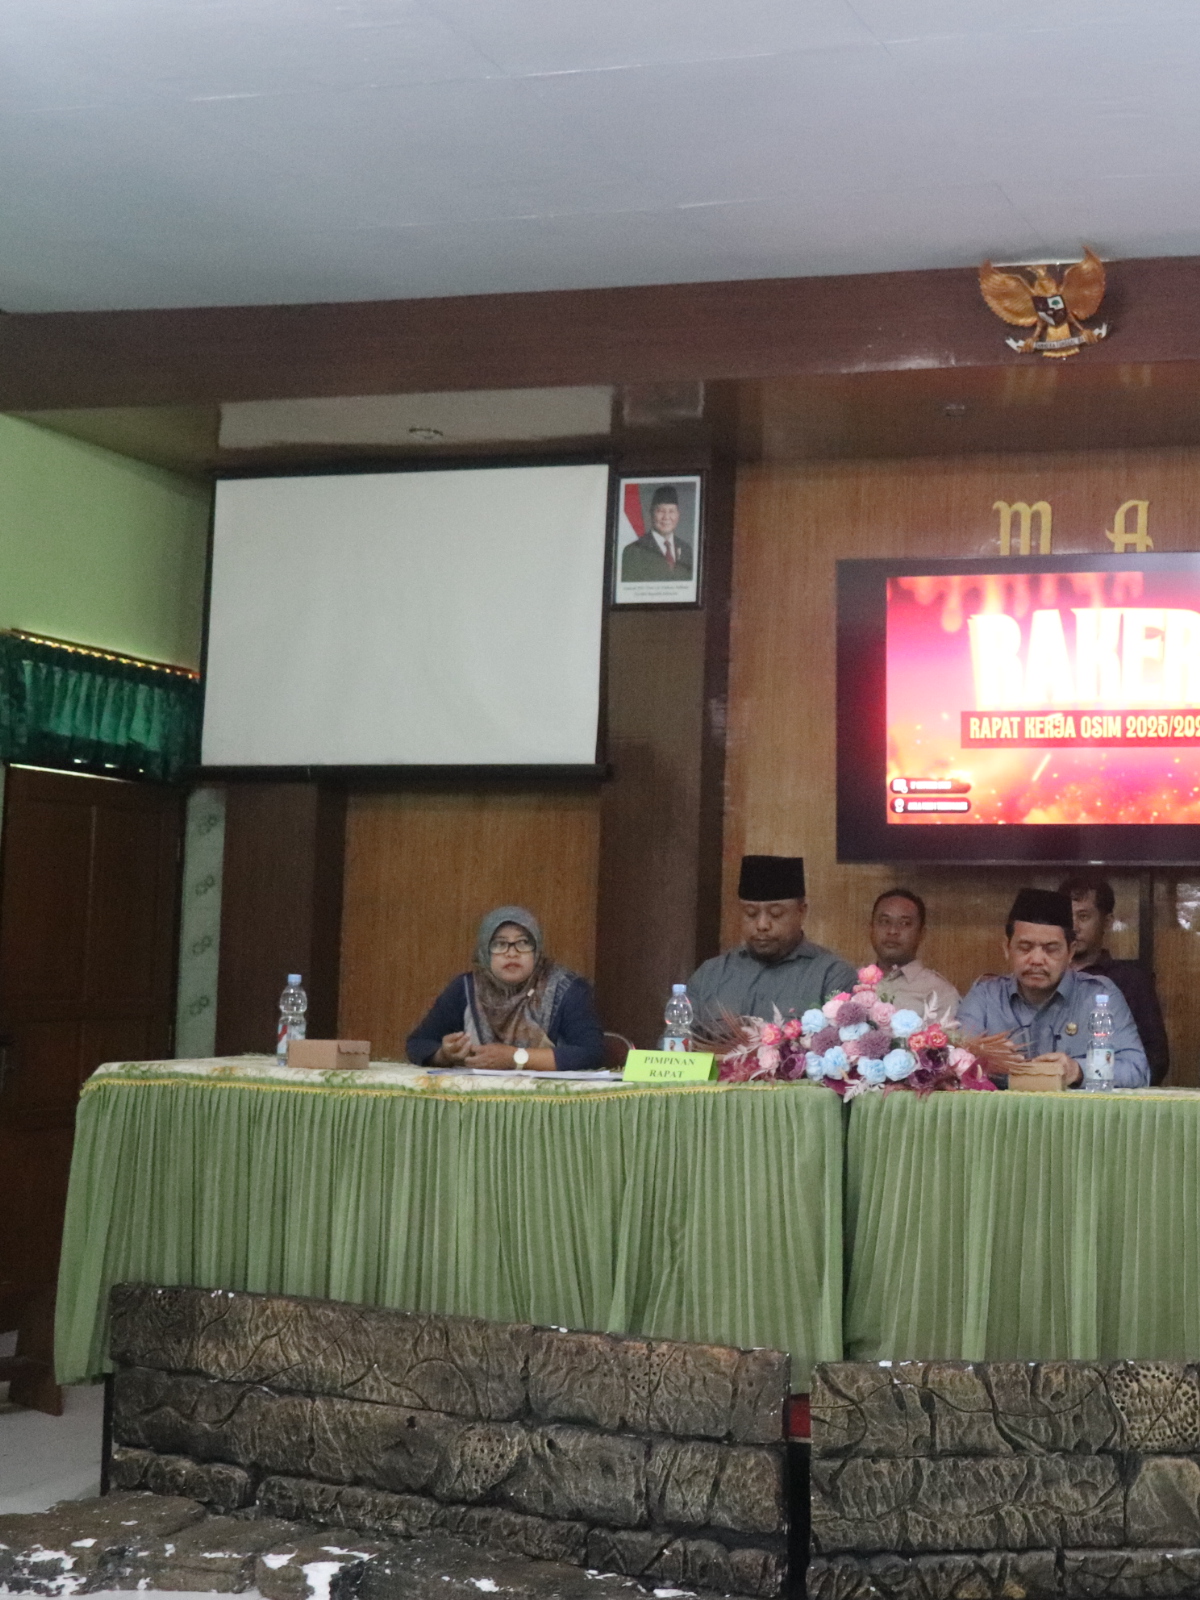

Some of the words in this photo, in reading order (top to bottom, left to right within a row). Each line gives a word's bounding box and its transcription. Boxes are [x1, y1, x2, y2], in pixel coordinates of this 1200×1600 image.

[969, 717, 1021, 739] RAPAT
[1024, 715, 1077, 739] KERJA
[1081, 716, 1121, 738] OSIM
[644, 1056, 695, 1066] PIMPINAN
[649, 1069, 684, 1079] RAPAT
